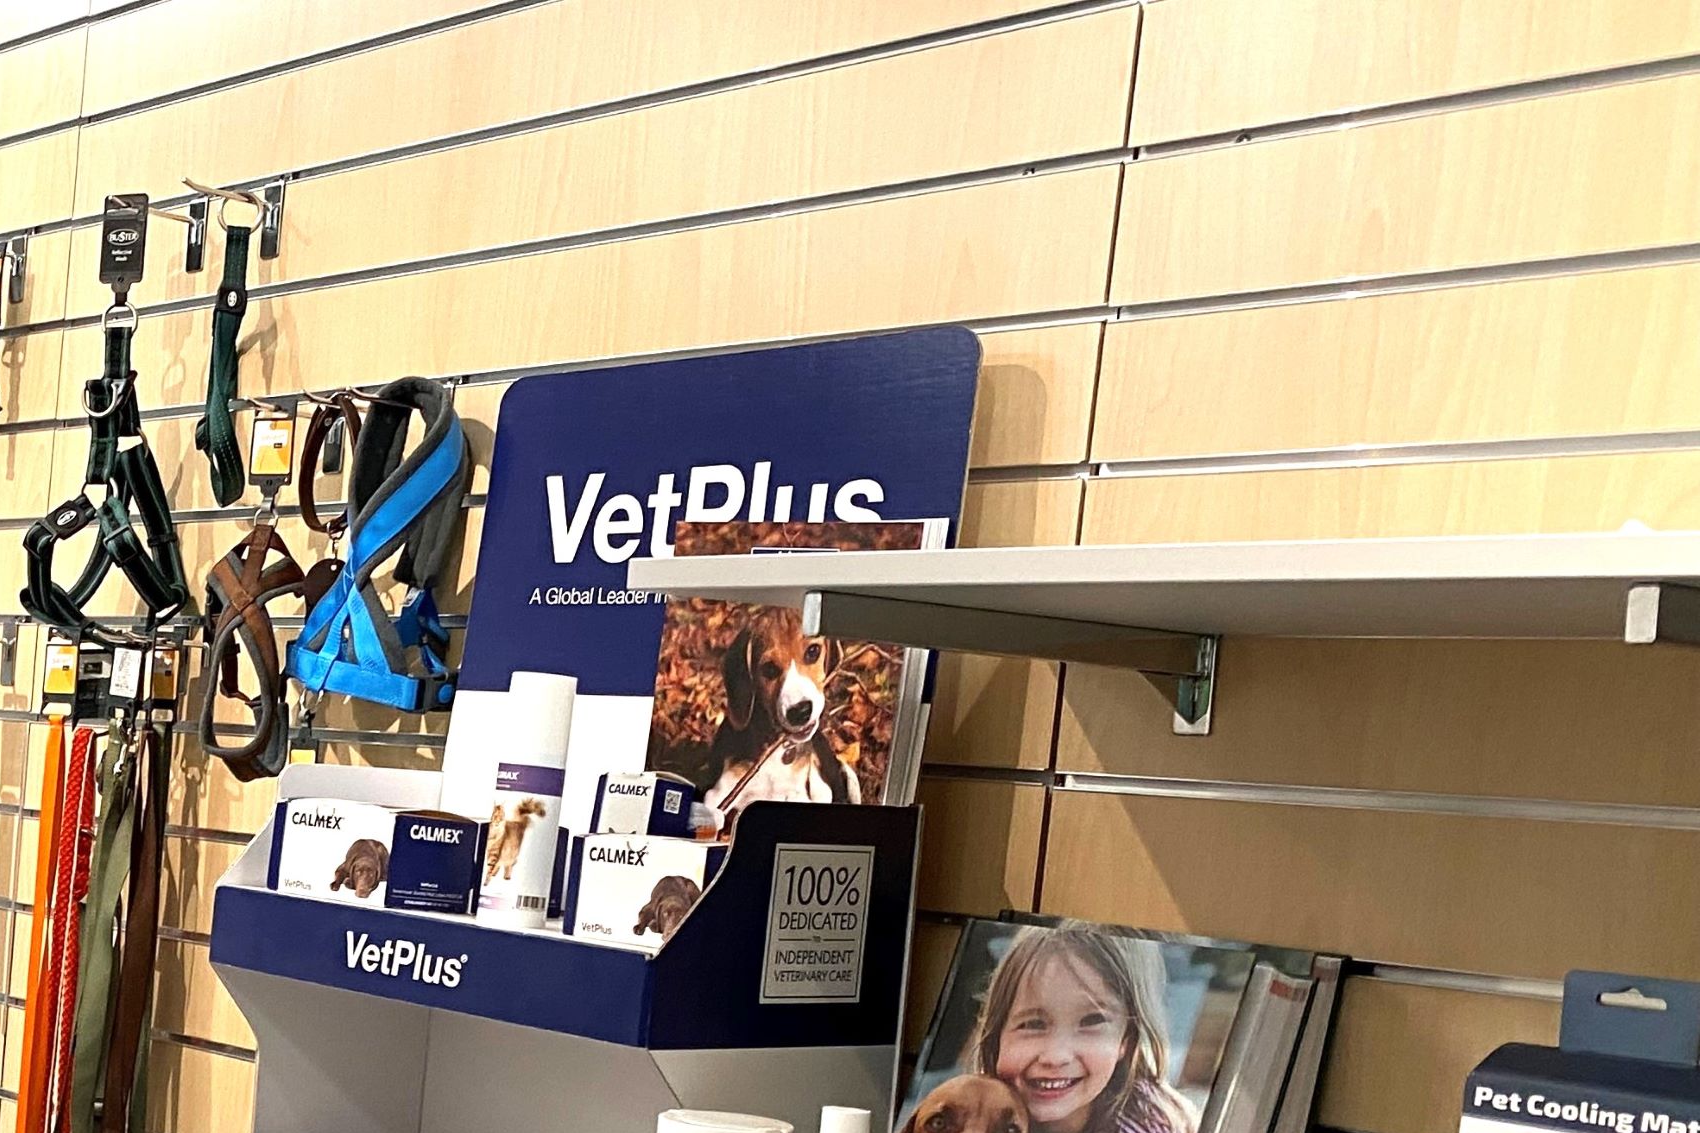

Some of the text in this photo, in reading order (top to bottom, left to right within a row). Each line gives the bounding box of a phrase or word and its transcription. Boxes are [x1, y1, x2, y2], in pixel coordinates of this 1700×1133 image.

[546, 461, 885, 564] VetPlus
[529, 588, 541, 605] A
[545, 587, 595, 605] Global
[609, 783, 649, 797] CALMEX
[292, 811, 342, 831] CALMEX
[410, 824, 461, 844] CALMEX
[589, 847, 646, 867] CALMEX
[785, 865, 861, 906] 100%
[582, 922, 612, 934] VetPlus
[779, 912, 858, 930] DEDICATED
[346, 930, 462, 988] VetPlus
[775, 950, 855, 965] INDEPENDENT
[774, 969, 852, 982] VETERINARY CARE
[1473, 1085, 1522, 1114] Pet
